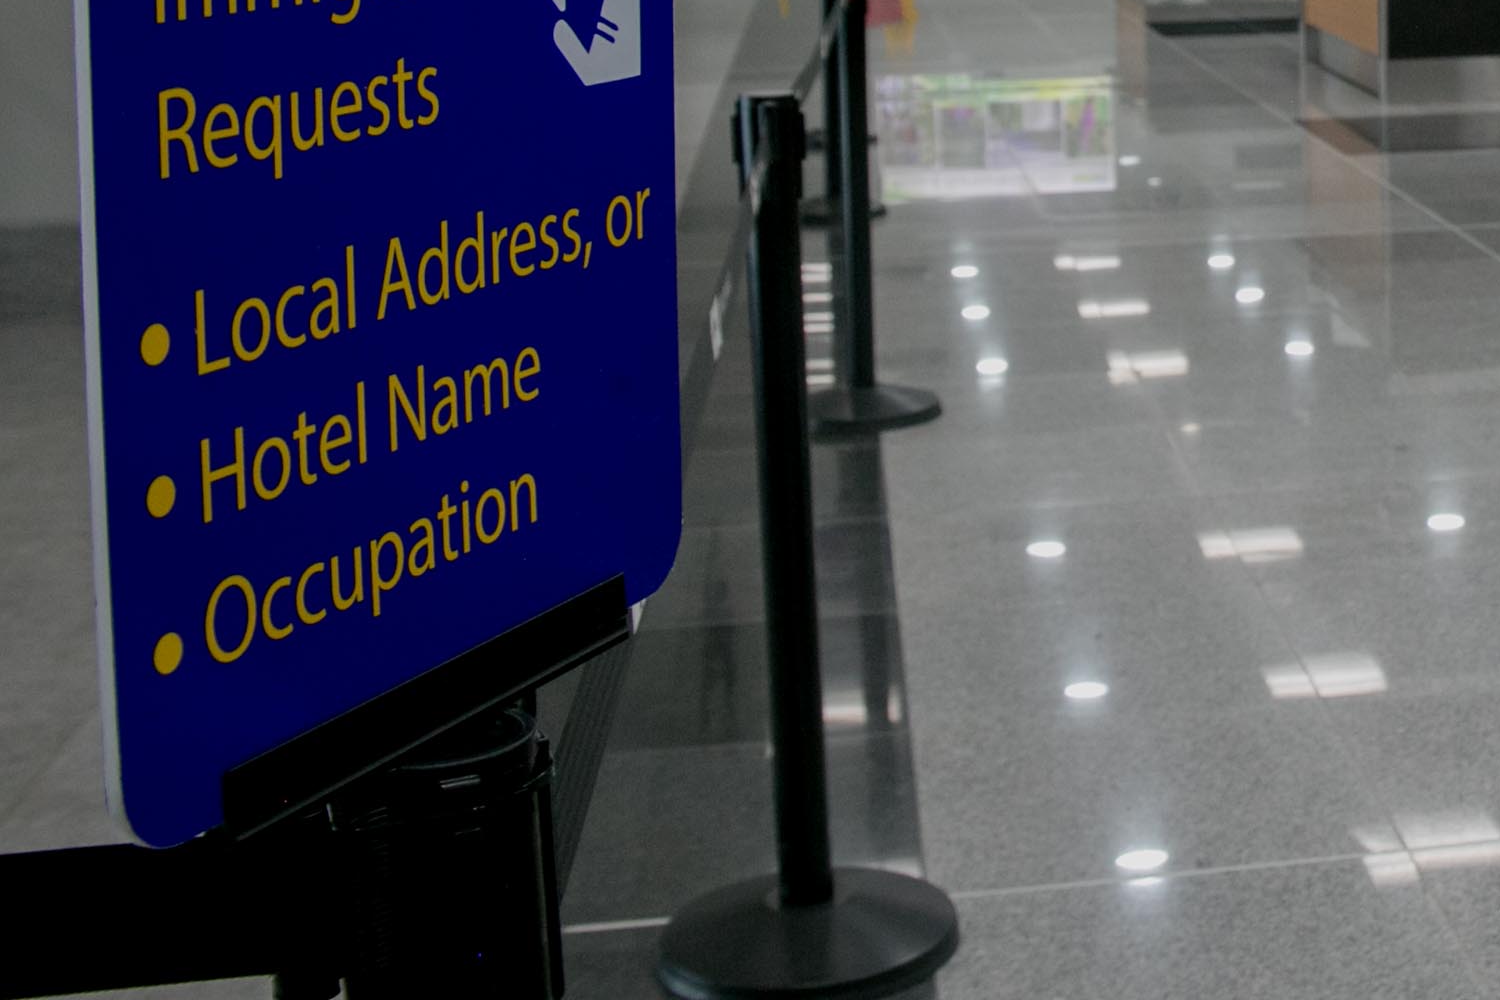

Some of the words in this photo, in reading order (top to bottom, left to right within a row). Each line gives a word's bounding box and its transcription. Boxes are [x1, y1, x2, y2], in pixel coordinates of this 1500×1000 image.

[156, 57, 441, 180] Requests
[194, 244, 357, 377] Local
[376, 207, 593, 321] Address,
[605, 187, 651, 248] or
[199, 381, 368, 524] Hotel
[387, 346, 541, 454] Name
[204, 472, 538, 664] Occupation
